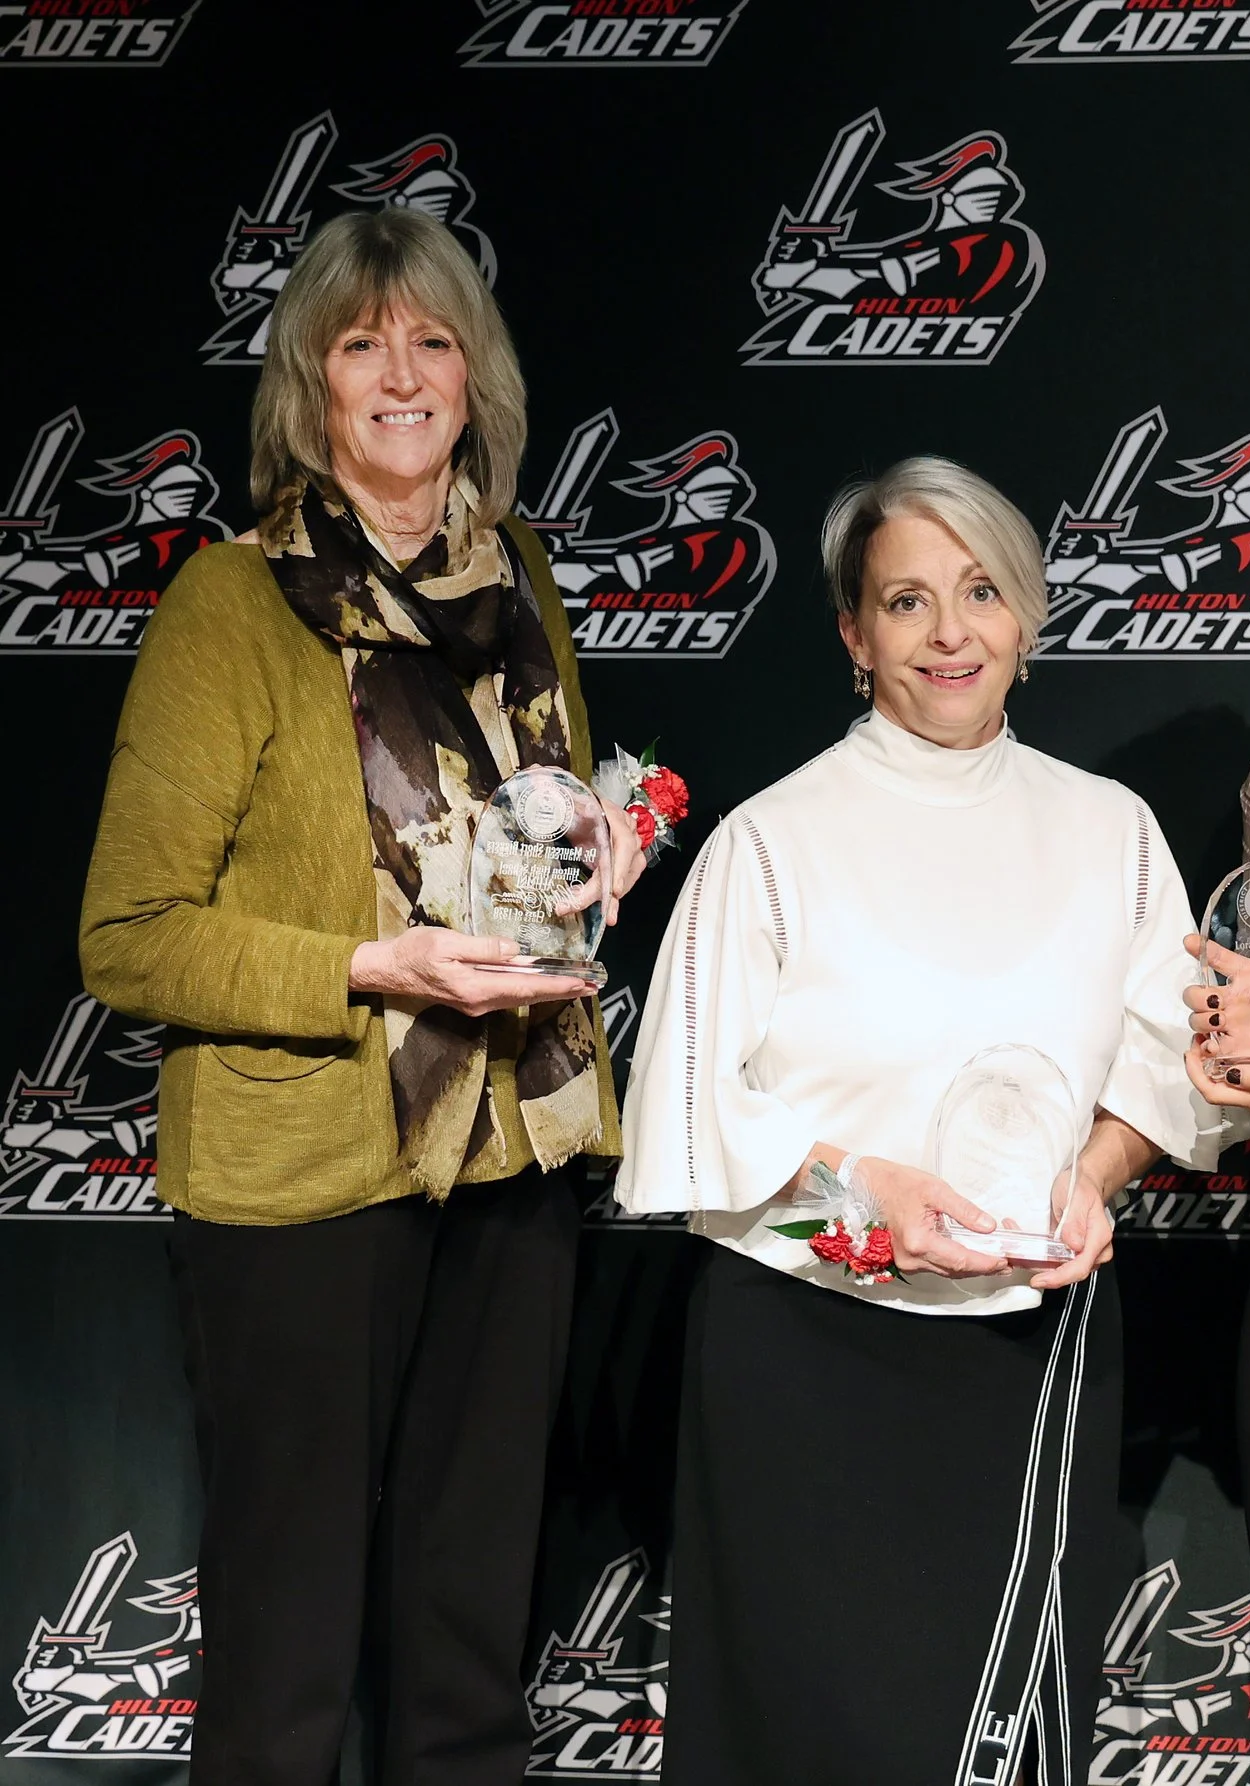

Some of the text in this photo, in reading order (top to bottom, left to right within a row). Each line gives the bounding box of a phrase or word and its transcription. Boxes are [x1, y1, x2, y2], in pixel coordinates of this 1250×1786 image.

[28, 0, 134, 16] HILTON
[570, 0, 692, 15] HILTON
[506, 6, 722, 57] CADETS
[852, 298, 966, 315] HILTON
[787, 304, 1005, 355] CADETS
[589, 593, 699, 609] HILTON
[1133, 594, 1246, 610] HILTON
[0, 596, 154, 645] CADE
[87, 1158, 157, 1173] HILT
[107, 1699, 197, 1715] HILTO
